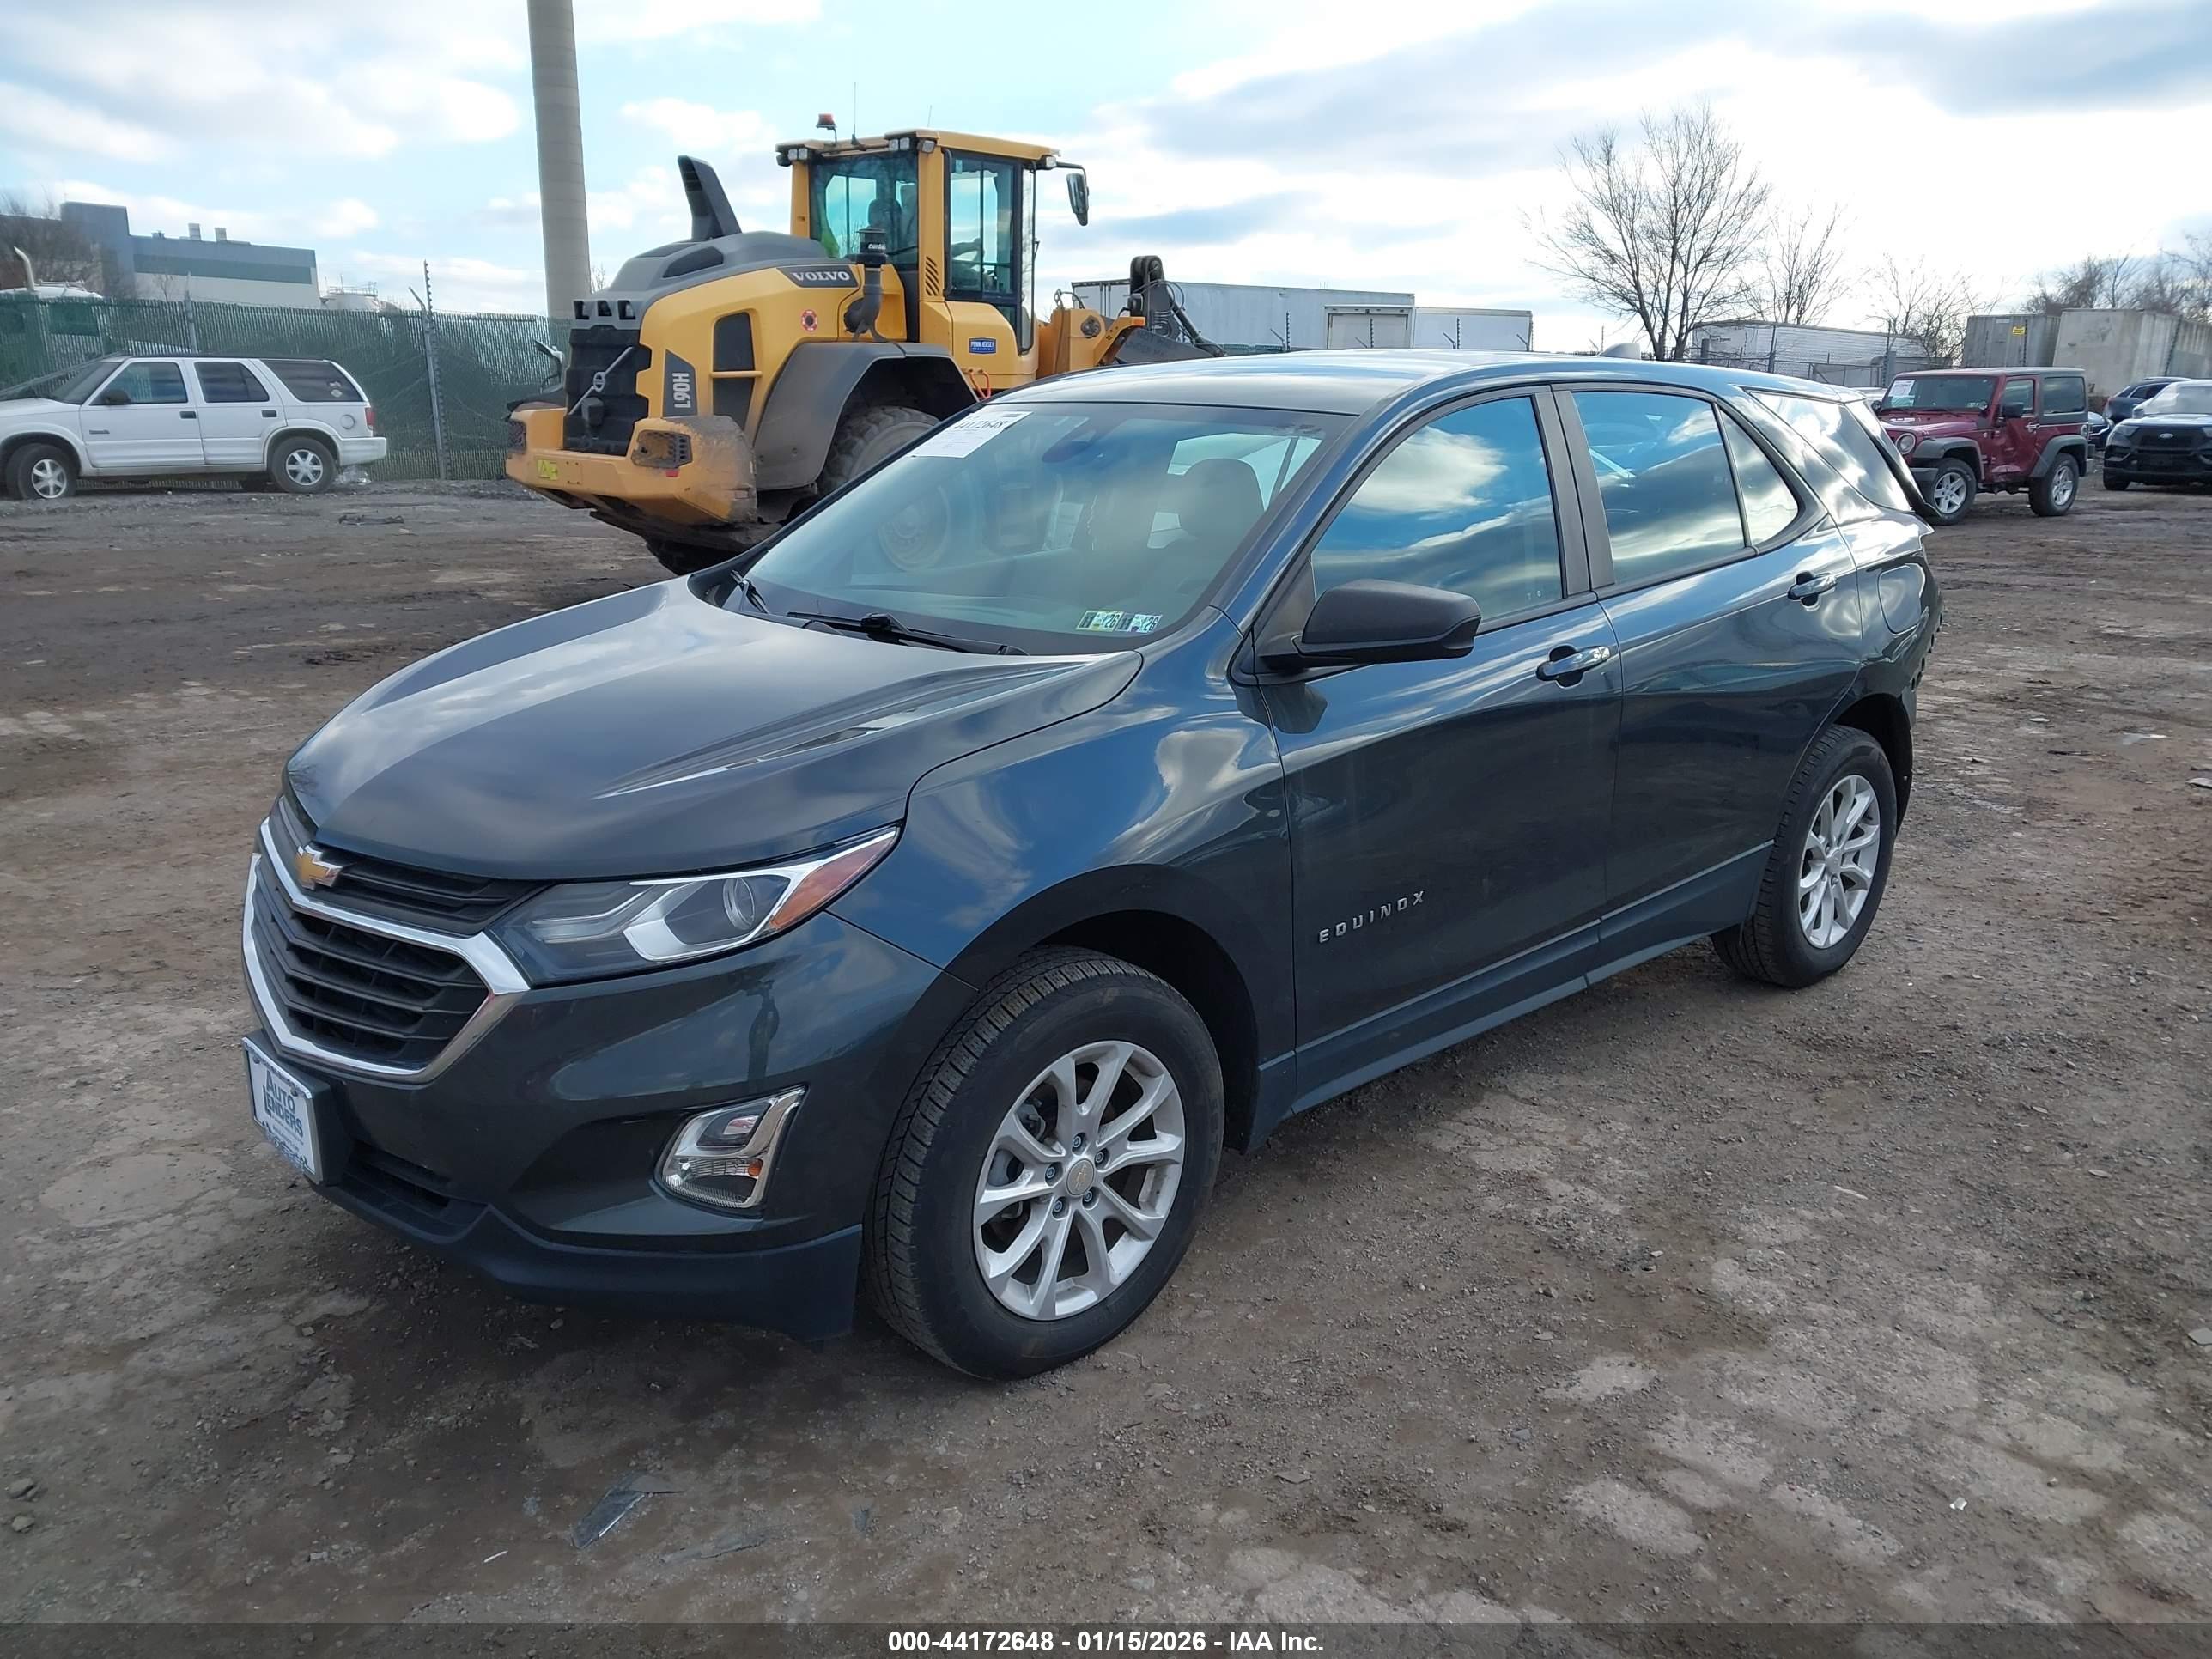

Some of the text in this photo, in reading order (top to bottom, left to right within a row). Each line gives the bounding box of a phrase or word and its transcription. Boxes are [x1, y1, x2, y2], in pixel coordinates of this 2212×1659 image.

[790, 271, 850, 282] VOLVO
[672, 372, 691, 408] L90H
[1319, 890, 1425, 943] EQUINOX
[265, 1069, 296, 1115] AUTO
